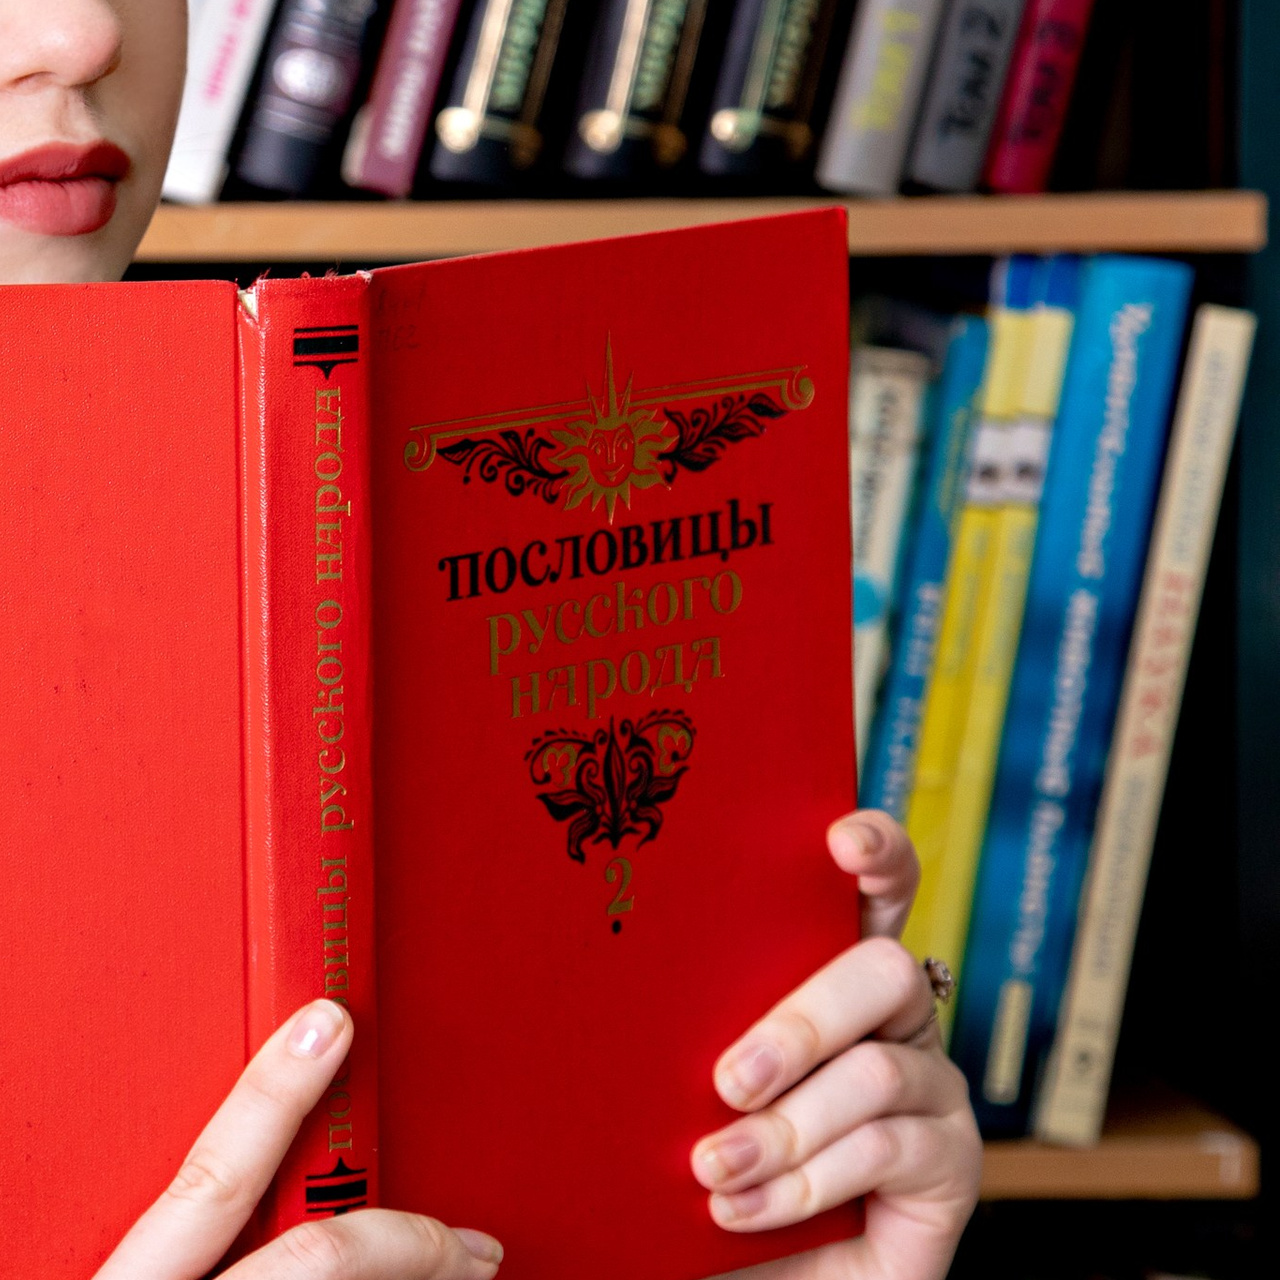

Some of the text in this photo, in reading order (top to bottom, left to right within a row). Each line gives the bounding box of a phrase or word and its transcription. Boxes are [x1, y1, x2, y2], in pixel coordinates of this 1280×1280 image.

[314, 383, 354, 585] народа
[438, 497, 775, 602] пословицы
[486, 569, 745, 675] русского
[311, 596, 354, 837] русского
[508, 634, 725, 723] народа
[605, 855, 636, 916] 2
